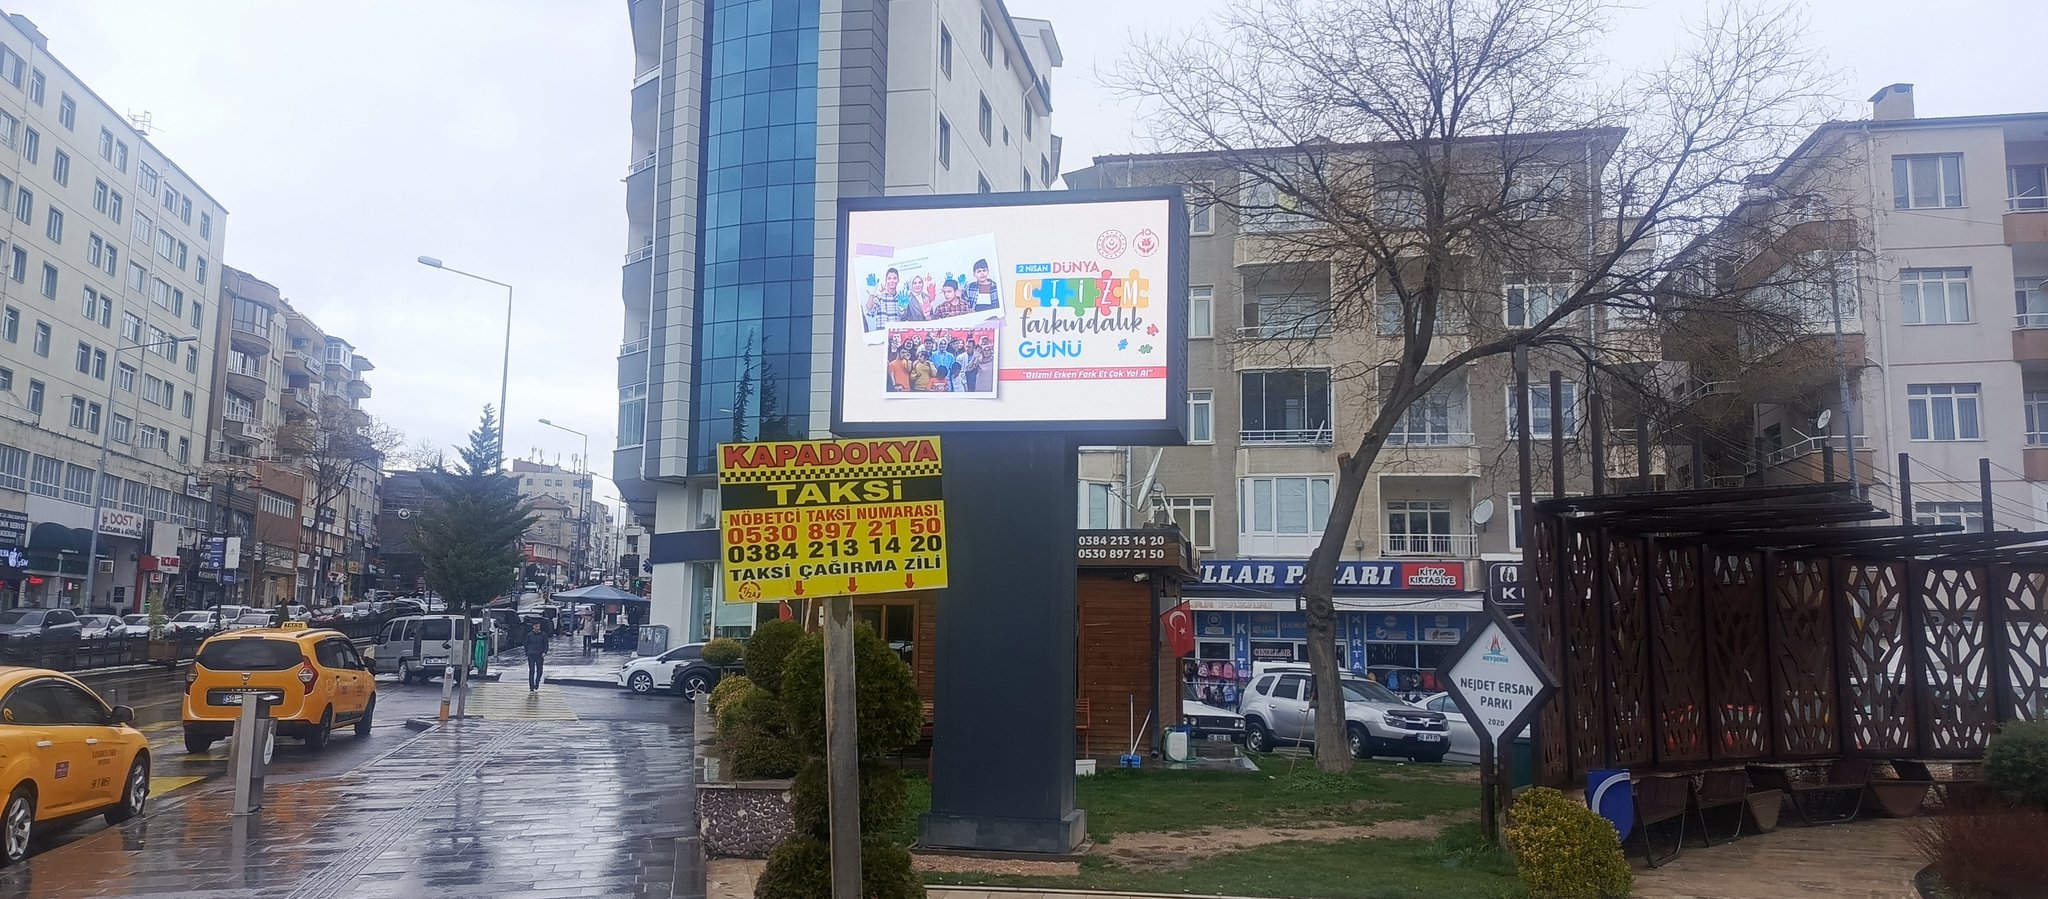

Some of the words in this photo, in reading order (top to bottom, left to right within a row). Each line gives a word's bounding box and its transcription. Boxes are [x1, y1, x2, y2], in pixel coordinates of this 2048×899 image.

[1053, 260, 1100, 274] DÜNYA
[1019, 306, 1143, 338] farkındalık
[1018, 340, 1082, 358] GÜNÜ
[1054, 371, 1077, 379] Erken
[1079, 370, 1097, 378] Fark
[1099, 370, 1107, 378] Et
[1126, 369, 1139, 377] Yol
[724, 440, 939, 469] KAPADOKYA
[110, 513, 133, 526] DOST
[729, 510, 800, 526] NÖBETCİ
[806, 506, 850, 522] TAKSİ
[857, 504, 939, 520] NUMARASI
[728, 525, 798, 545] 0530
[808, 522, 857, 540] 897
[868, 520, 897, 537] 21
[910, 517, 942, 535] 50
[1078, 536, 1107, 545] 0384
[1110, 536, 1130, 545] 213
[1133, 536, 1146, 545] 14
[1149, 536, 1164, 545] 20
[728, 543, 799, 563] 0384
[808, 539, 859, 558] 213
[870, 537, 901, 555] 14
[910, 535, 942, 552] 20
[1078, 549, 1106, 558] 0530
[1109, 549, 1130, 558] 897
[1133, 549, 1146, 558] 21
[1149, 549, 1164, 558] 50
[730, 563, 791, 581] TAKSİ
[799, 560, 897, 580] ÇAĞIRMA
[904, 554, 941, 571] ZİLİ
[1200, 565, 1275, 584] LLAR
[1419, 566, 1446, 576] KİTAP
[1409, 576, 1456, 585] KIRTASİYE
[1460, 677, 1495, 691] NEJDET
[1498, 682, 1534, 696] ERSAN
[1480, 696, 1512, 710] PARKI
[1488, 718, 1505, 727] 2020
